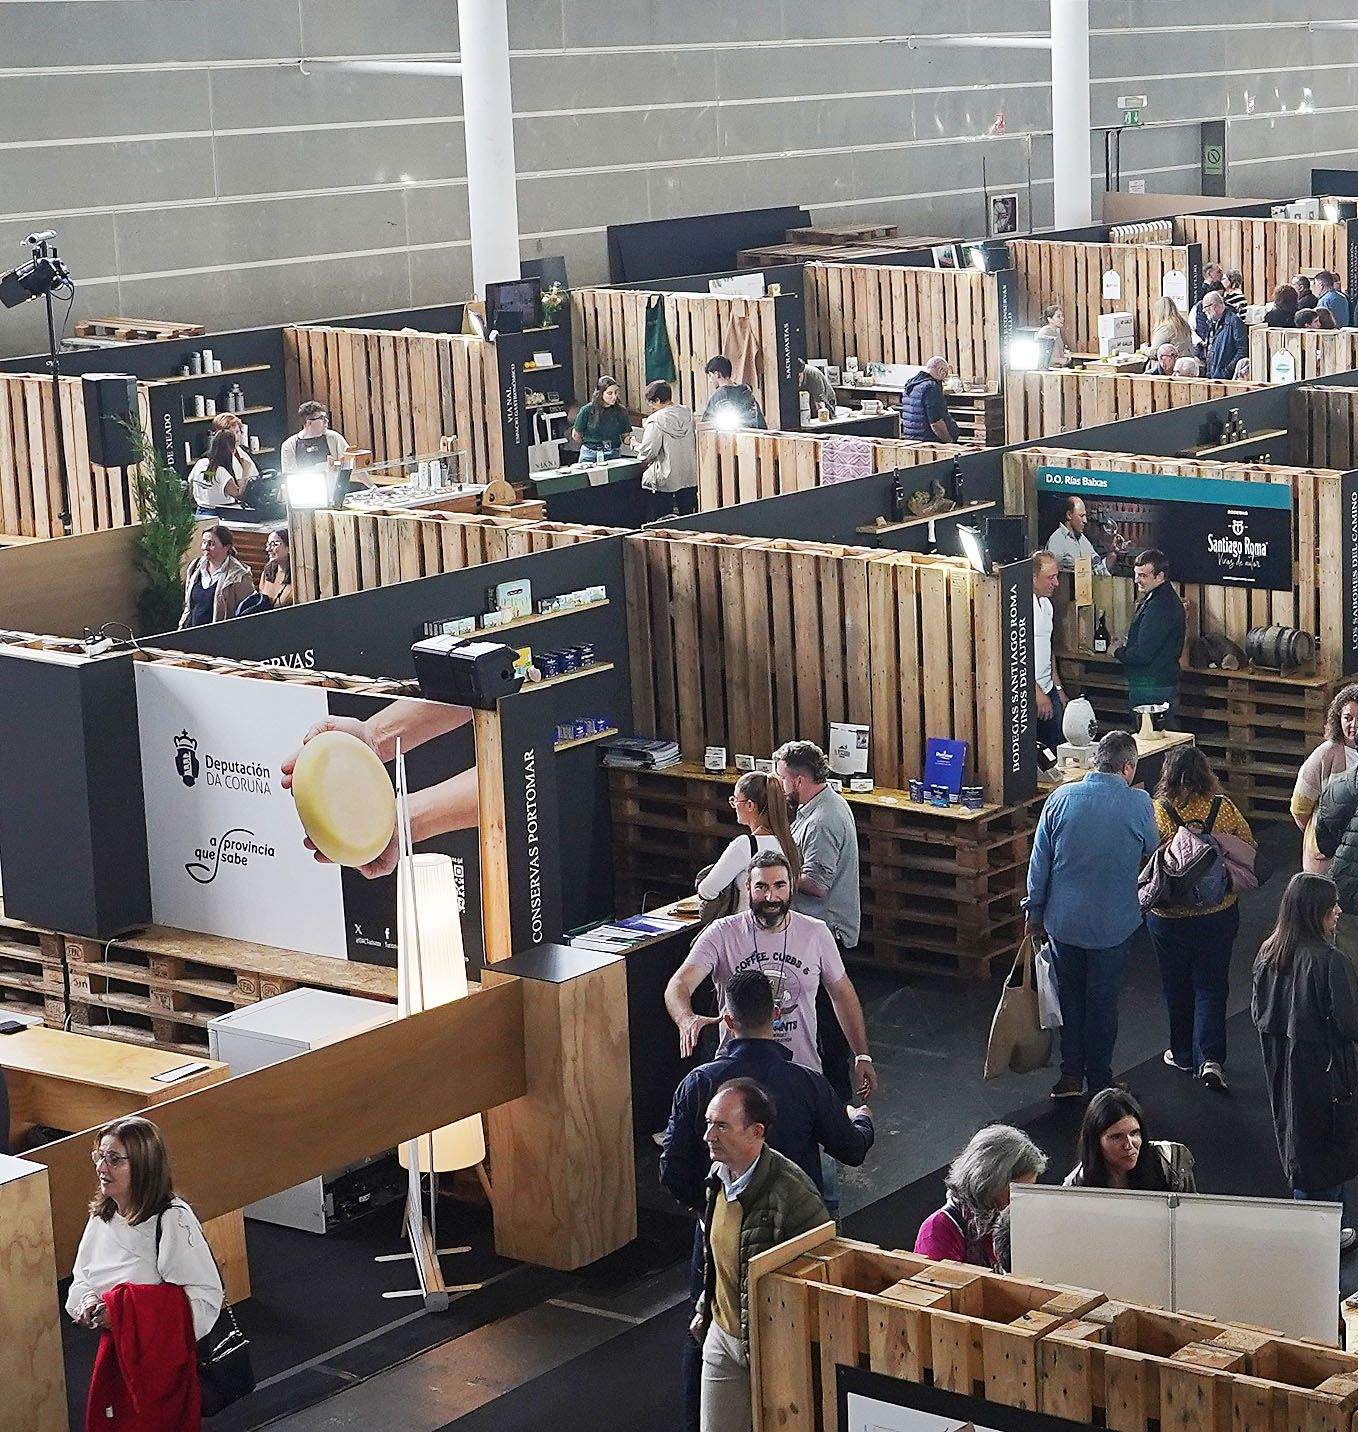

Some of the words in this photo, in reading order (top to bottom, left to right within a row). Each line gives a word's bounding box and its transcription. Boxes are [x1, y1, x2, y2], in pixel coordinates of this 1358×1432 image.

[1207, 533, 1243, 558] Santiago
[1244, 536, 1267, 559] Roma
[1010, 583, 1018, 628] ROMA
[1018, 617, 1027, 665] AUTOR
[1010, 630, 1019, 703] SANTIAGO
[1019, 667, 1027, 688] DE
[1019, 690, 1028, 733] VINOS
[1011, 706, 1020, 773] BODEGAS
[205, 754, 270, 779] Deputación
[206, 771, 222, 788] DA
[225, 775, 272, 796] CORUÑA
[523, 748, 538, 843] PORTOMAR
[194, 848, 216, 861] que
[221, 852, 248, 866] sabe
[209, 837, 217, 847] a
[223, 839, 275, 857] provincia
[527, 846, 543, 944] CONSERVAS
